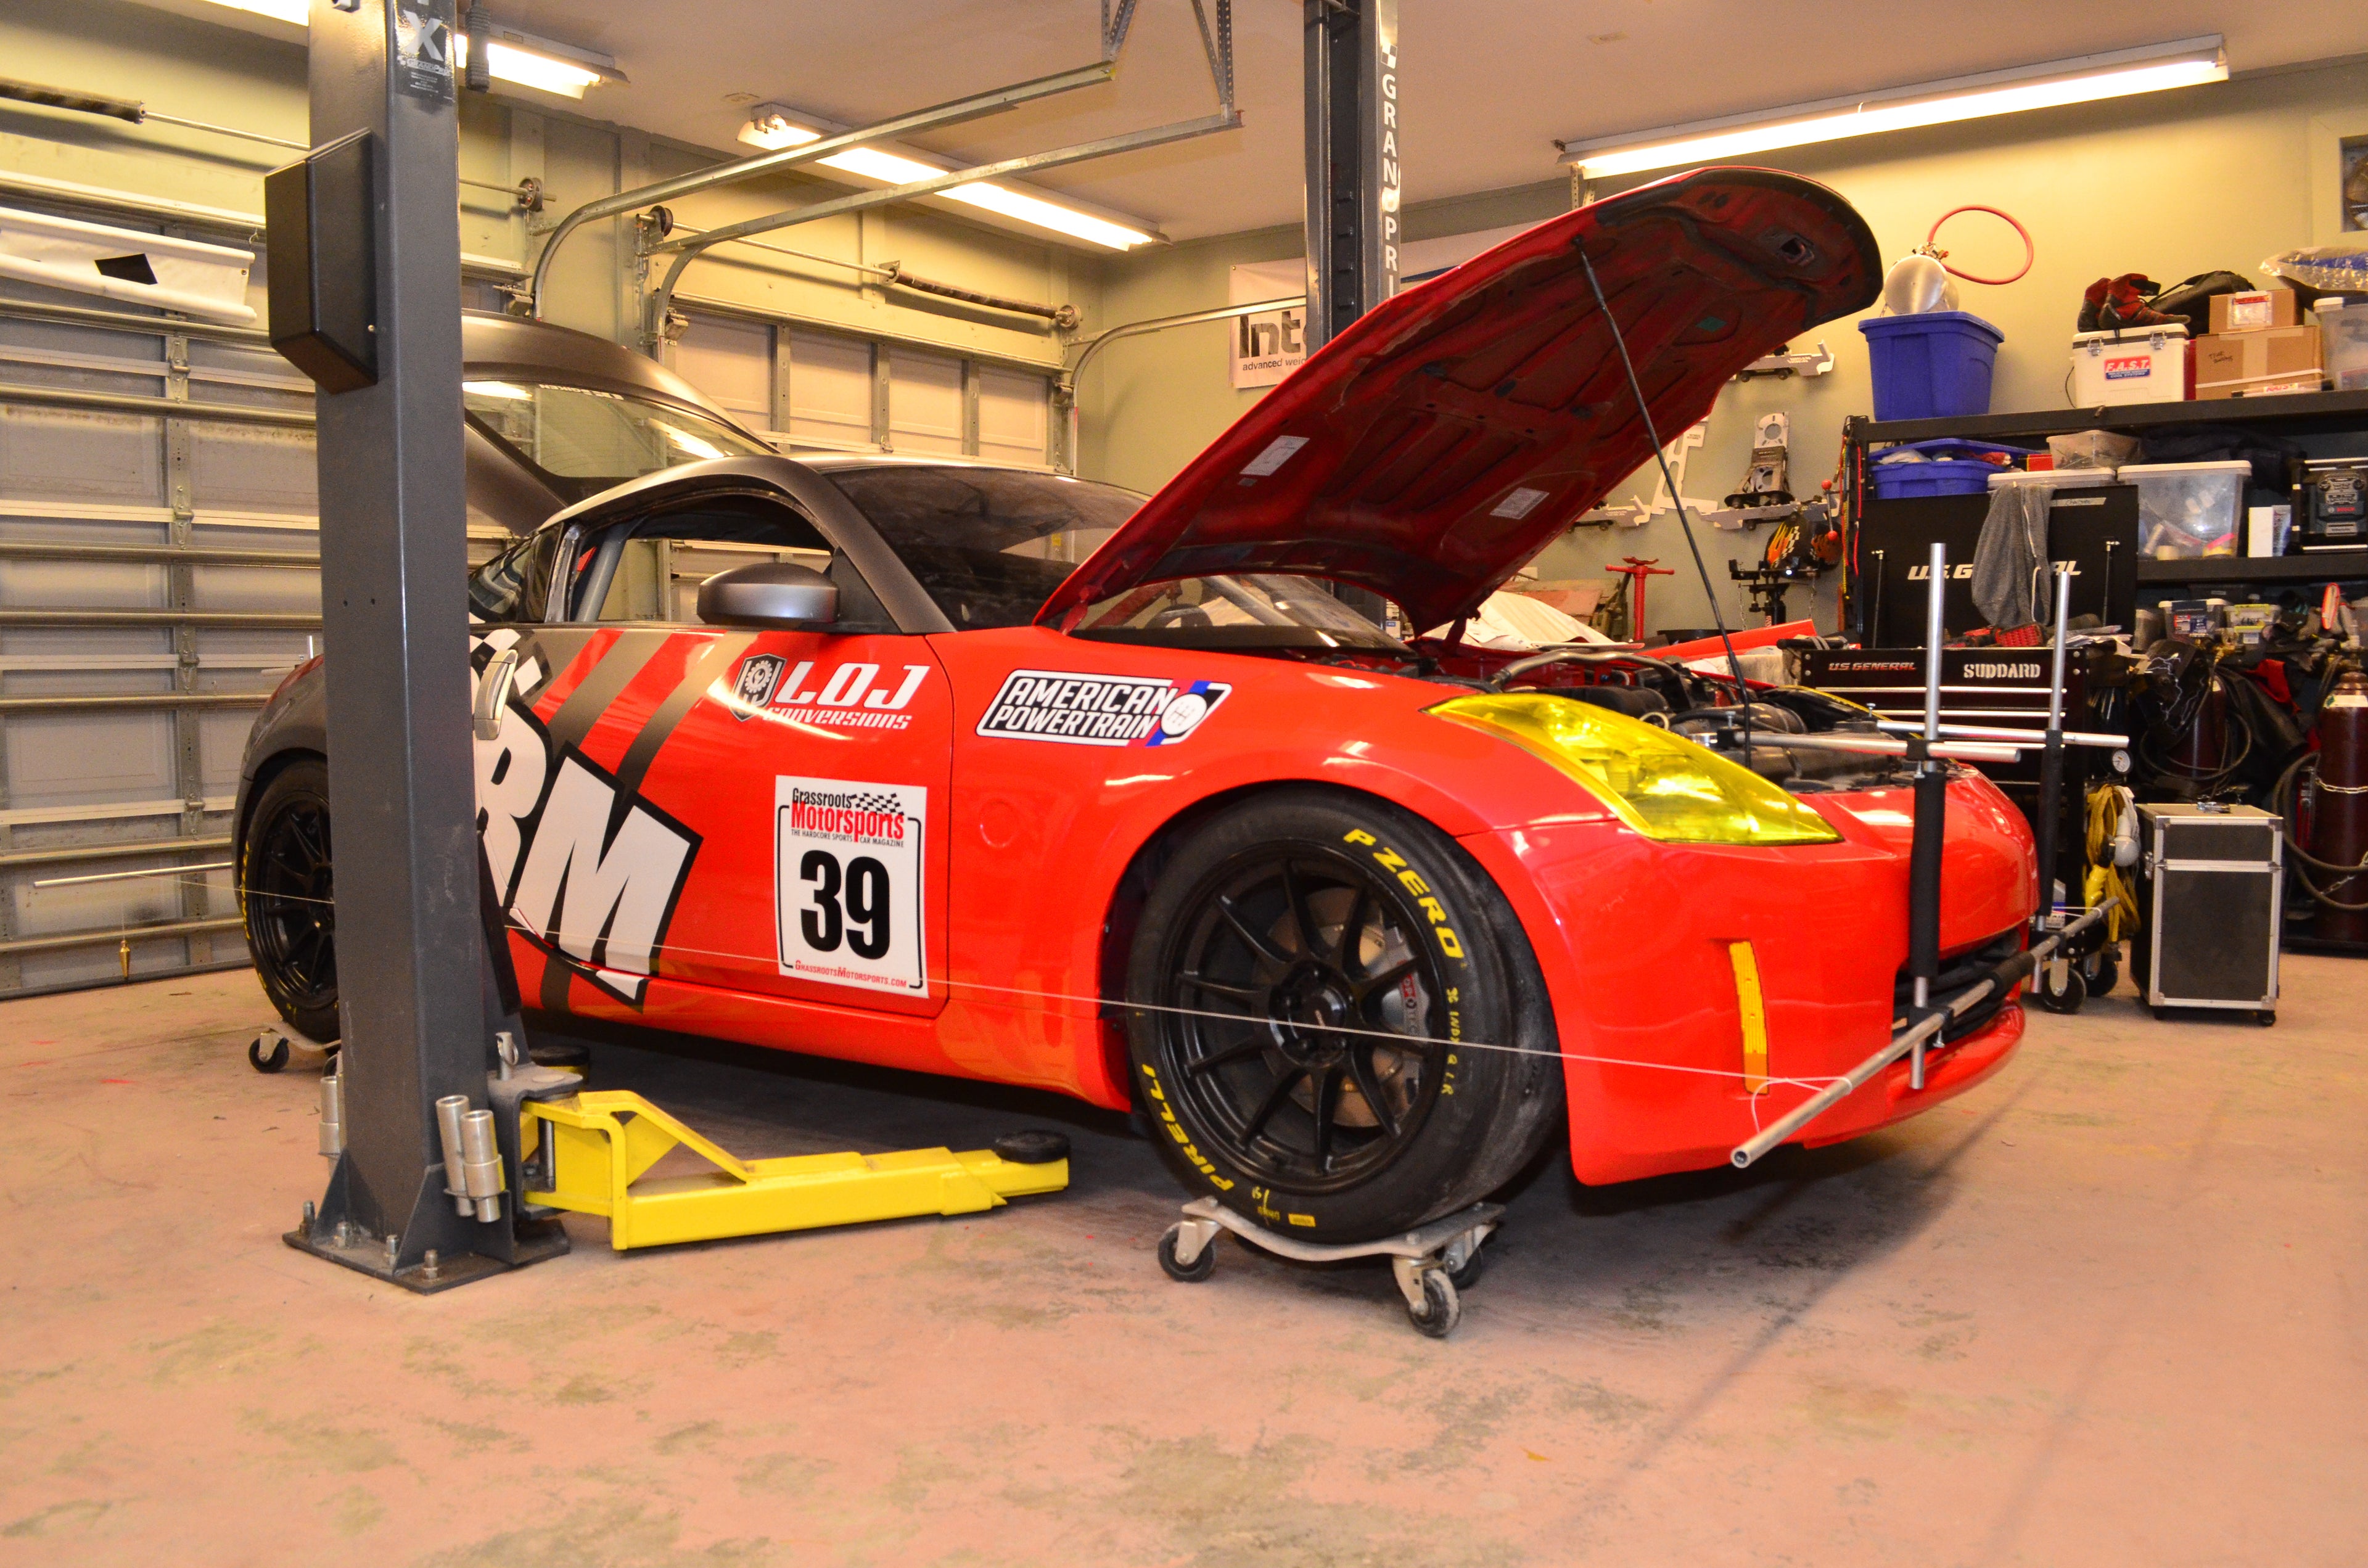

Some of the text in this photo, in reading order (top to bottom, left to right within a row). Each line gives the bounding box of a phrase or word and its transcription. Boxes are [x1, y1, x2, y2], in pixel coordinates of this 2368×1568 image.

[403, 0, 444, 62] X
[1239, 310, 1307, 358] Int
[1243, 358, 1283, 371] advanced
[2105, 359, 2150, 373] F.A.S.T.
[775, 660, 931, 710] LOJ
[1828, 662, 1917, 671] US GENERAL
[1963, 663, 2041, 678] SUDDARD
[1004, 678, 1179, 715] AMERICAN
[989, 705, 1161, 739] POWERTRAIN
[792, 787, 852, 809] Grassroots
[791, 800, 905, 842] Motorsports
[791, 829, 904, 848] THE HARDCORE SPORTS CAR MAGAZINE
[800, 850, 890, 960] 39
[1343, 828, 1465, 959] P ZERO
[1142, 1064, 1235, 1191] PIRELLI
